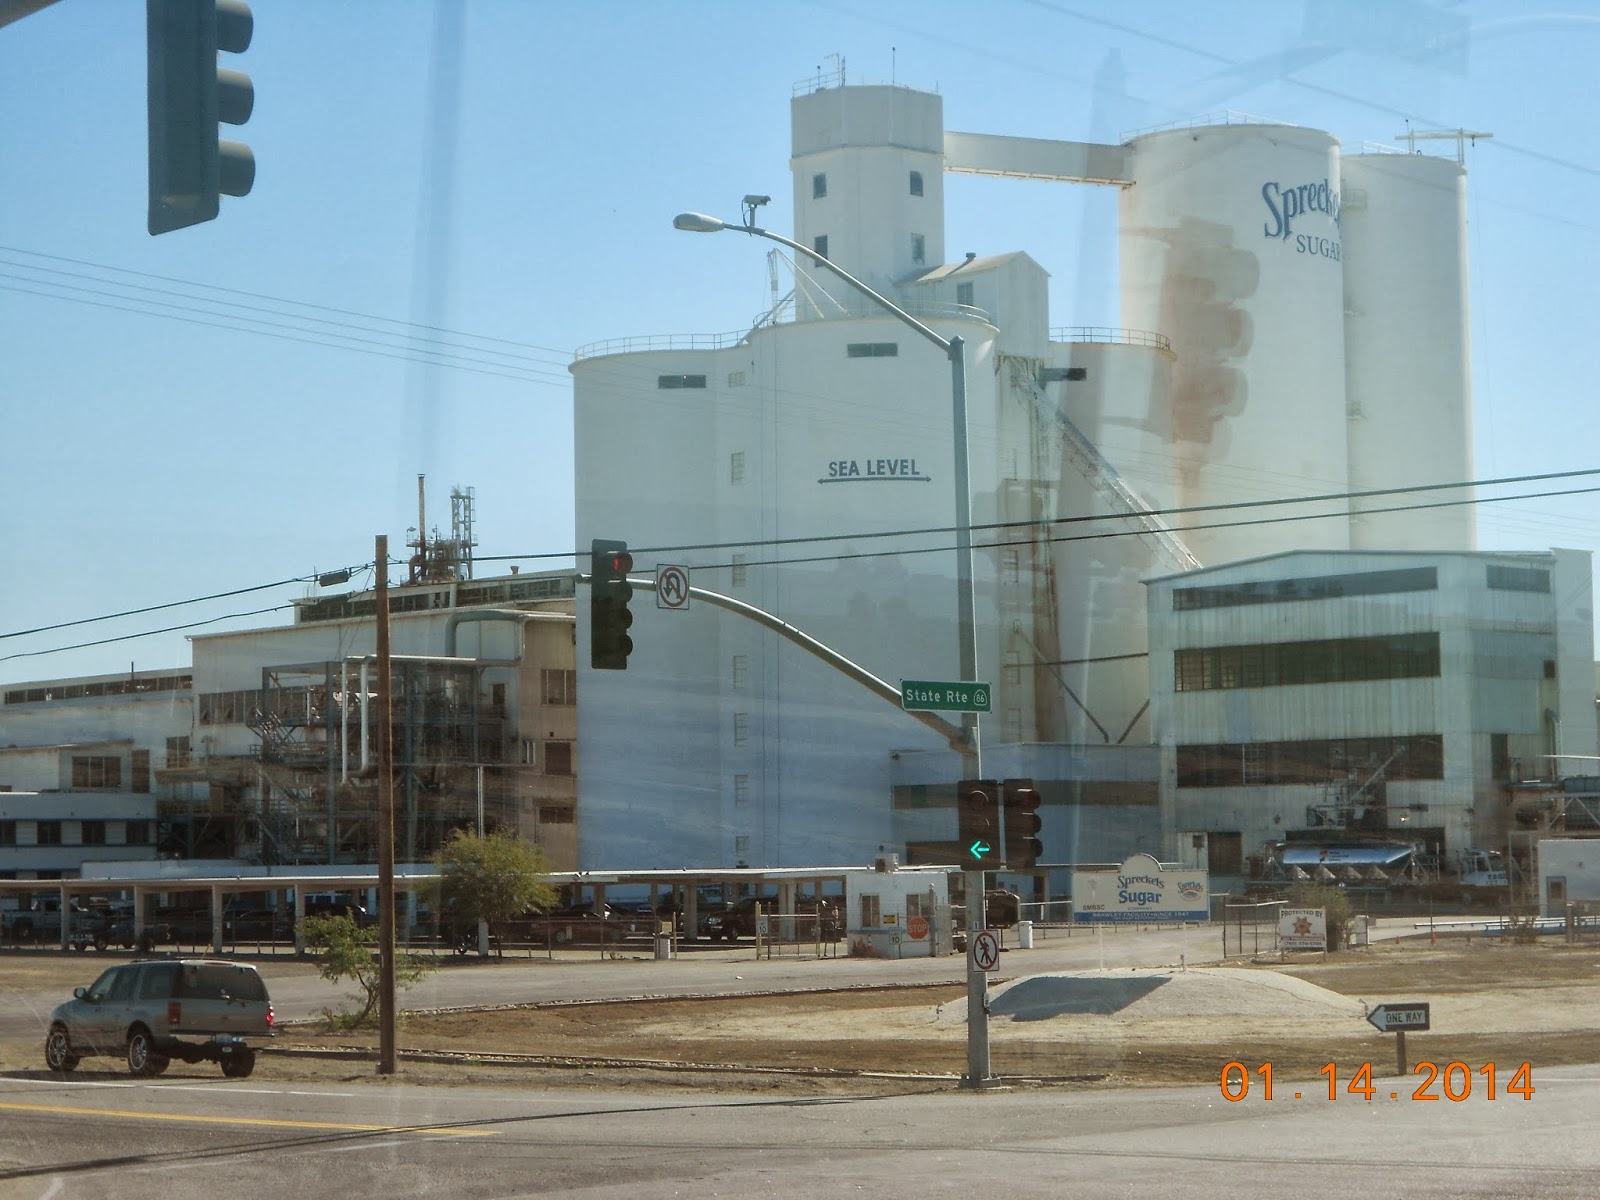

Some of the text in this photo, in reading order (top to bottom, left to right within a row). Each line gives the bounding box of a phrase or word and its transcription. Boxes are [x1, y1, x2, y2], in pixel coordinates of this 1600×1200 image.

[1262, 178, 1341, 241] Sprecke
[828, 459, 920, 477] SEA LEVEL
[906, 689, 985, 703] State Rte 86
[1117, 875, 1165, 889] Spreckels
[1118, 890, 1162, 906] Sugar
[1280, 910, 1323, 919] PROTECTED BY
[908, 923, 927, 933] STOP
[891, 936, 900, 944] 10
[1386, 1011, 1423, 1024] ONE WAY
